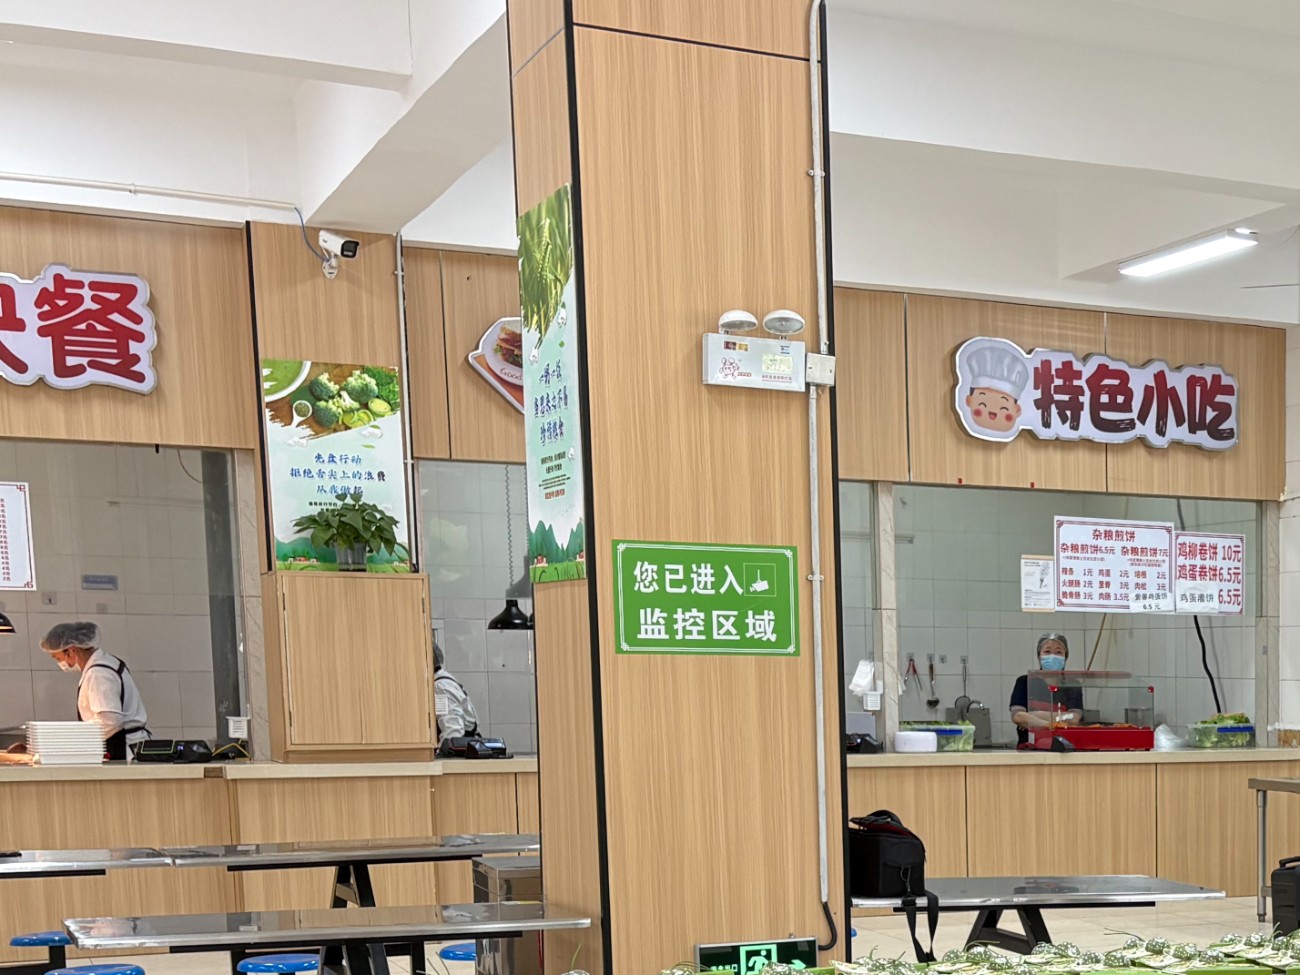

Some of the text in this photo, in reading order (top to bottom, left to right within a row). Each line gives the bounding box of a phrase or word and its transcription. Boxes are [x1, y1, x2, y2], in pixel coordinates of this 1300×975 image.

[1033, 359, 1235, 440] 特色小吃
[314, 452, 362, 465] 光盘行动
[290, 467, 386, 482] 拒绝舌尖上的浪费
[316, 484, 364, 496] 从我做起
[1092, 528, 1136, 542] 杂粮煎饼
[1178, 542, 1241, 562] 鸡柳卷饼 10元
[633, 561, 743, 595] 您已进入
[1083, 568, 1094, 577] 1元
[1098, 568, 1111, 578] 鸡蛋
[1119, 569, 1130, 579] 2元
[1156, 571, 1166, 580] 2元
[1061, 579, 1080, 588] 火腿肠
[1083, 580, 1094, 589] 2元
[1119, 581, 1130, 590] 3元
[1156, 582, 1166, 592] 3元
[1083, 591, 1094, 600] 3元
[1113, 592, 1130, 602] 3.5元
[1218, 588, 1241, 606] 6.5元
[637, 608, 777, 642] 监控区域
